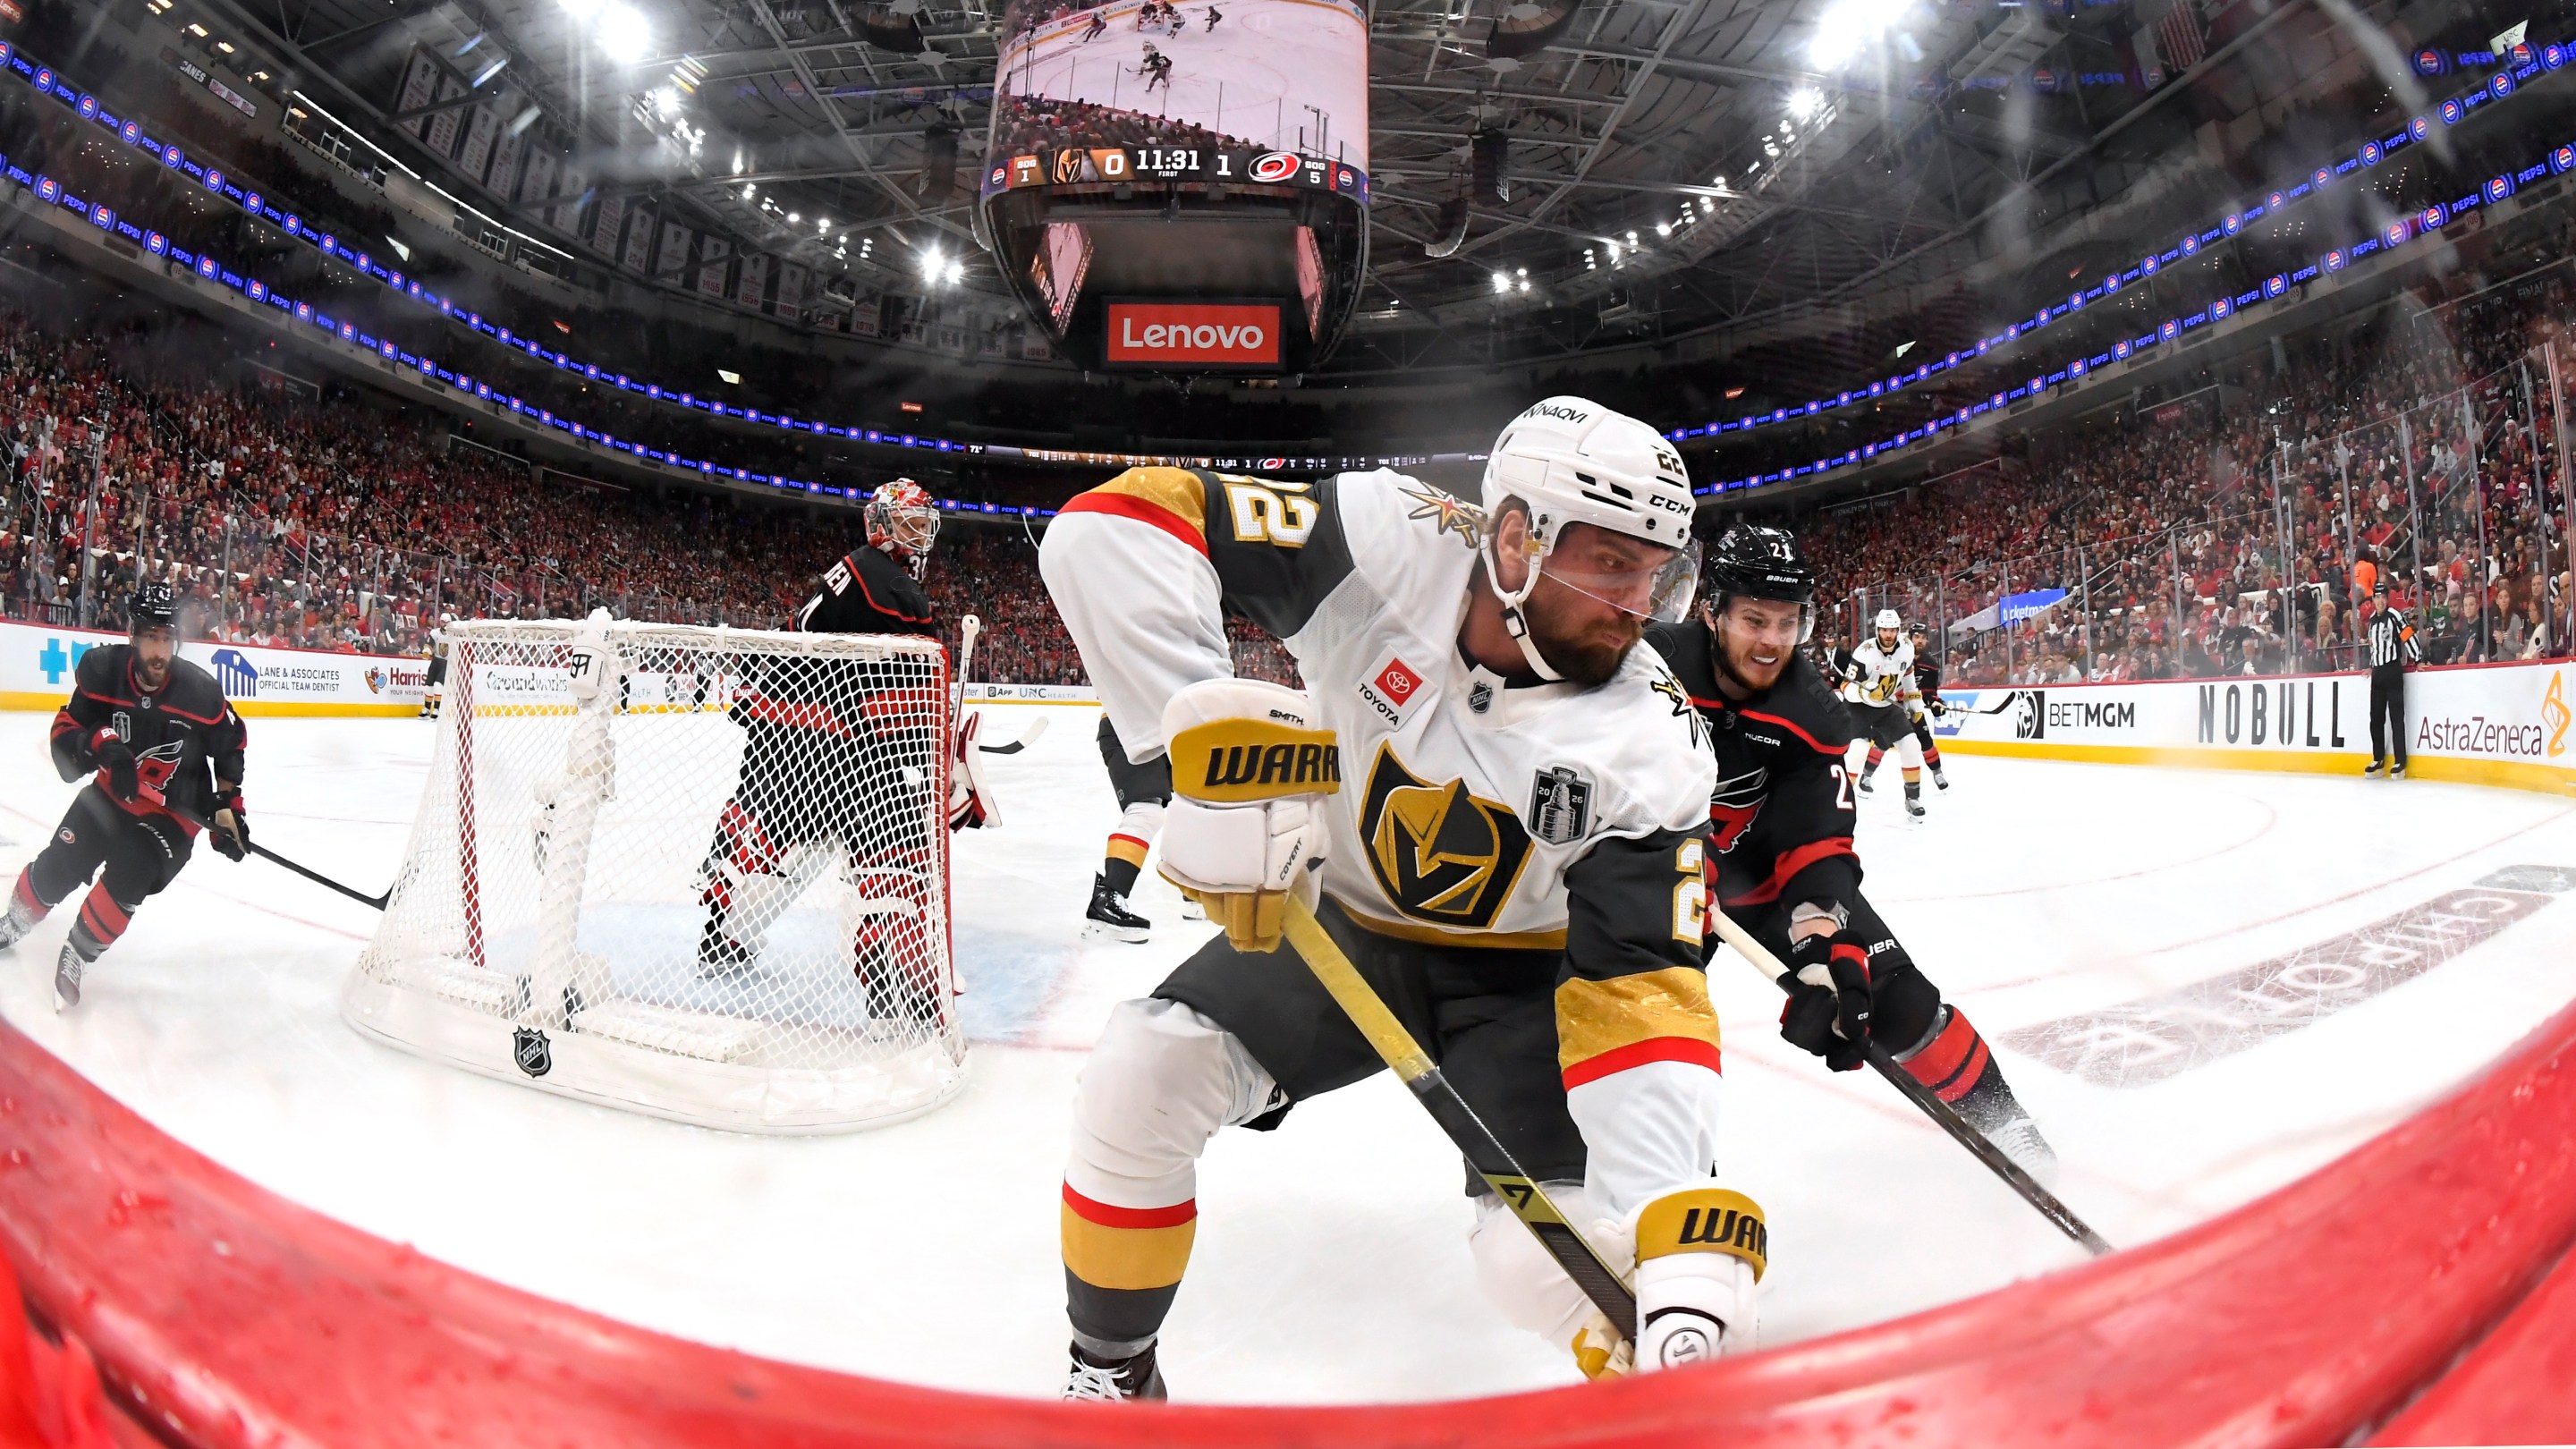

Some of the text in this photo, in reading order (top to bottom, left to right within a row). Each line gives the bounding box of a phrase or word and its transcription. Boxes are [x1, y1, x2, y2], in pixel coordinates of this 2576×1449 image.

[2517, 60, 2540, 79] PEPSI
[2082, 74, 2104, 84] PEPSI
[2107, 74, 2123, 82] PEPSI
[2464, 90, 2488, 106] PEPSI
[2385, 132, 2407, 149] PEPSI
[13, 57, 32, 75] PEPSI
[55, 86, 75, 101] PEPSI
[99, 112, 118, 127] PEPSI
[142, 138, 162, 152] PEPSI
[183, 161, 203, 176] PEPSI
[225, 185, 243, 199] PEPSI
[265, 208, 282, 220] PEPSI
[302, 228, 318, 241] PEPSI
[338, 246, 354, 261] PEPSI
[1016, 159, 1036, 170] SOG
[1105, 154, 1124, 175] 0
[1137, 149, 1200, 170] 11:31
[1216, 155, 1232, 176] 1
[1305, 161, 1326, 171] SOG
[2335, 159, 2359, 174] PEPSI
[1021, 170, 1030, 182] 1
[1158, 170, 1179, 178] FIRST
[1309, 172, 1321, 184] 5
[2289, 182, 2310, 197] PEPSI
[2243, 206, 2265, 220] PEPSI
[2466, 211, 2478, 225] 106
[2200, 229, 2221, 242] PEPSI
[2160, 250, 2179, 262] PEPSI
[2123, 269, 2140, 281] PEPSI
[1973, 402, 1989, 412] PEPSI
[2009, 387, 2026, 399] PEPSI
[2048, 371, 2066, 384] PEPSI
[2089, 352, 2109, 367] PEPSI
[2135, 334, 2156, 348] PEPSI
[2182, 313, 2207, 327] PEPSI
[2236, 290, 2259, 306] PEPSI
[2292, 265, 2318, 282] PEPSI
[2351, 238, 2379, 258] PEPSI
[2452, 193, 2479, 213] PEPSI
[2518, 163, 2546, 183] PEPSI
[2086, 287, 2102, 298] PEPSI
[7, 165, 34, 185] PEPSI
[63, 194, 88, 213] PEPSI
[118, 221, 141, 239] PEPSI
[171, 247, 193, 265] PEPSI
[222, 270, 243, 288] PEPSI
[270, 293, 291, 309] PEPSI
[316, 314, 336, 330] PEPSI
[360, 334, 378, 348] PEPSI
[400, 352, 417, 365] PEPSI
[751, 474, 767, 482] PEPSI
[1123, 318, 1265, 350] Lenovo
[902, 403, 921, 411] Lenovo
[1216, 459, 1238, 467] 11:31
[1245, 459, 1250, 468] 1
[1648, 493, 1690, 517] CCM
[909, 555, 928, 583] 31
[1766, 573, 1799, 584] BAUER
[259, 666, 340, 681] LANE & ASSOCIATES
[259, 680, 340, 692] OFFICIAL TEAM DENTIST
[487, 671, 568, 692] Groundworks
[1019, 687, 1046, 699] UNC
[1471, 693, 1489, 704] NHL
[1359, 683, 1401, 726] TOYOTA
[1269, 709, 1305, 726] SMITH
[2049, 702, 2135, 728] BETMGM
[2198, 681, 2345, 748] NOBULL
[1745, 732, 1781, 747] NUCOR
[2417, 716, 2542, 757] AstraZeneca
[1538, 786, 1550, 797] 20
[1572, 794, 1584, 805] 26
[1279, 837, 1302, 882] COVERT
[522, 1043, 542, 1063] NHL
